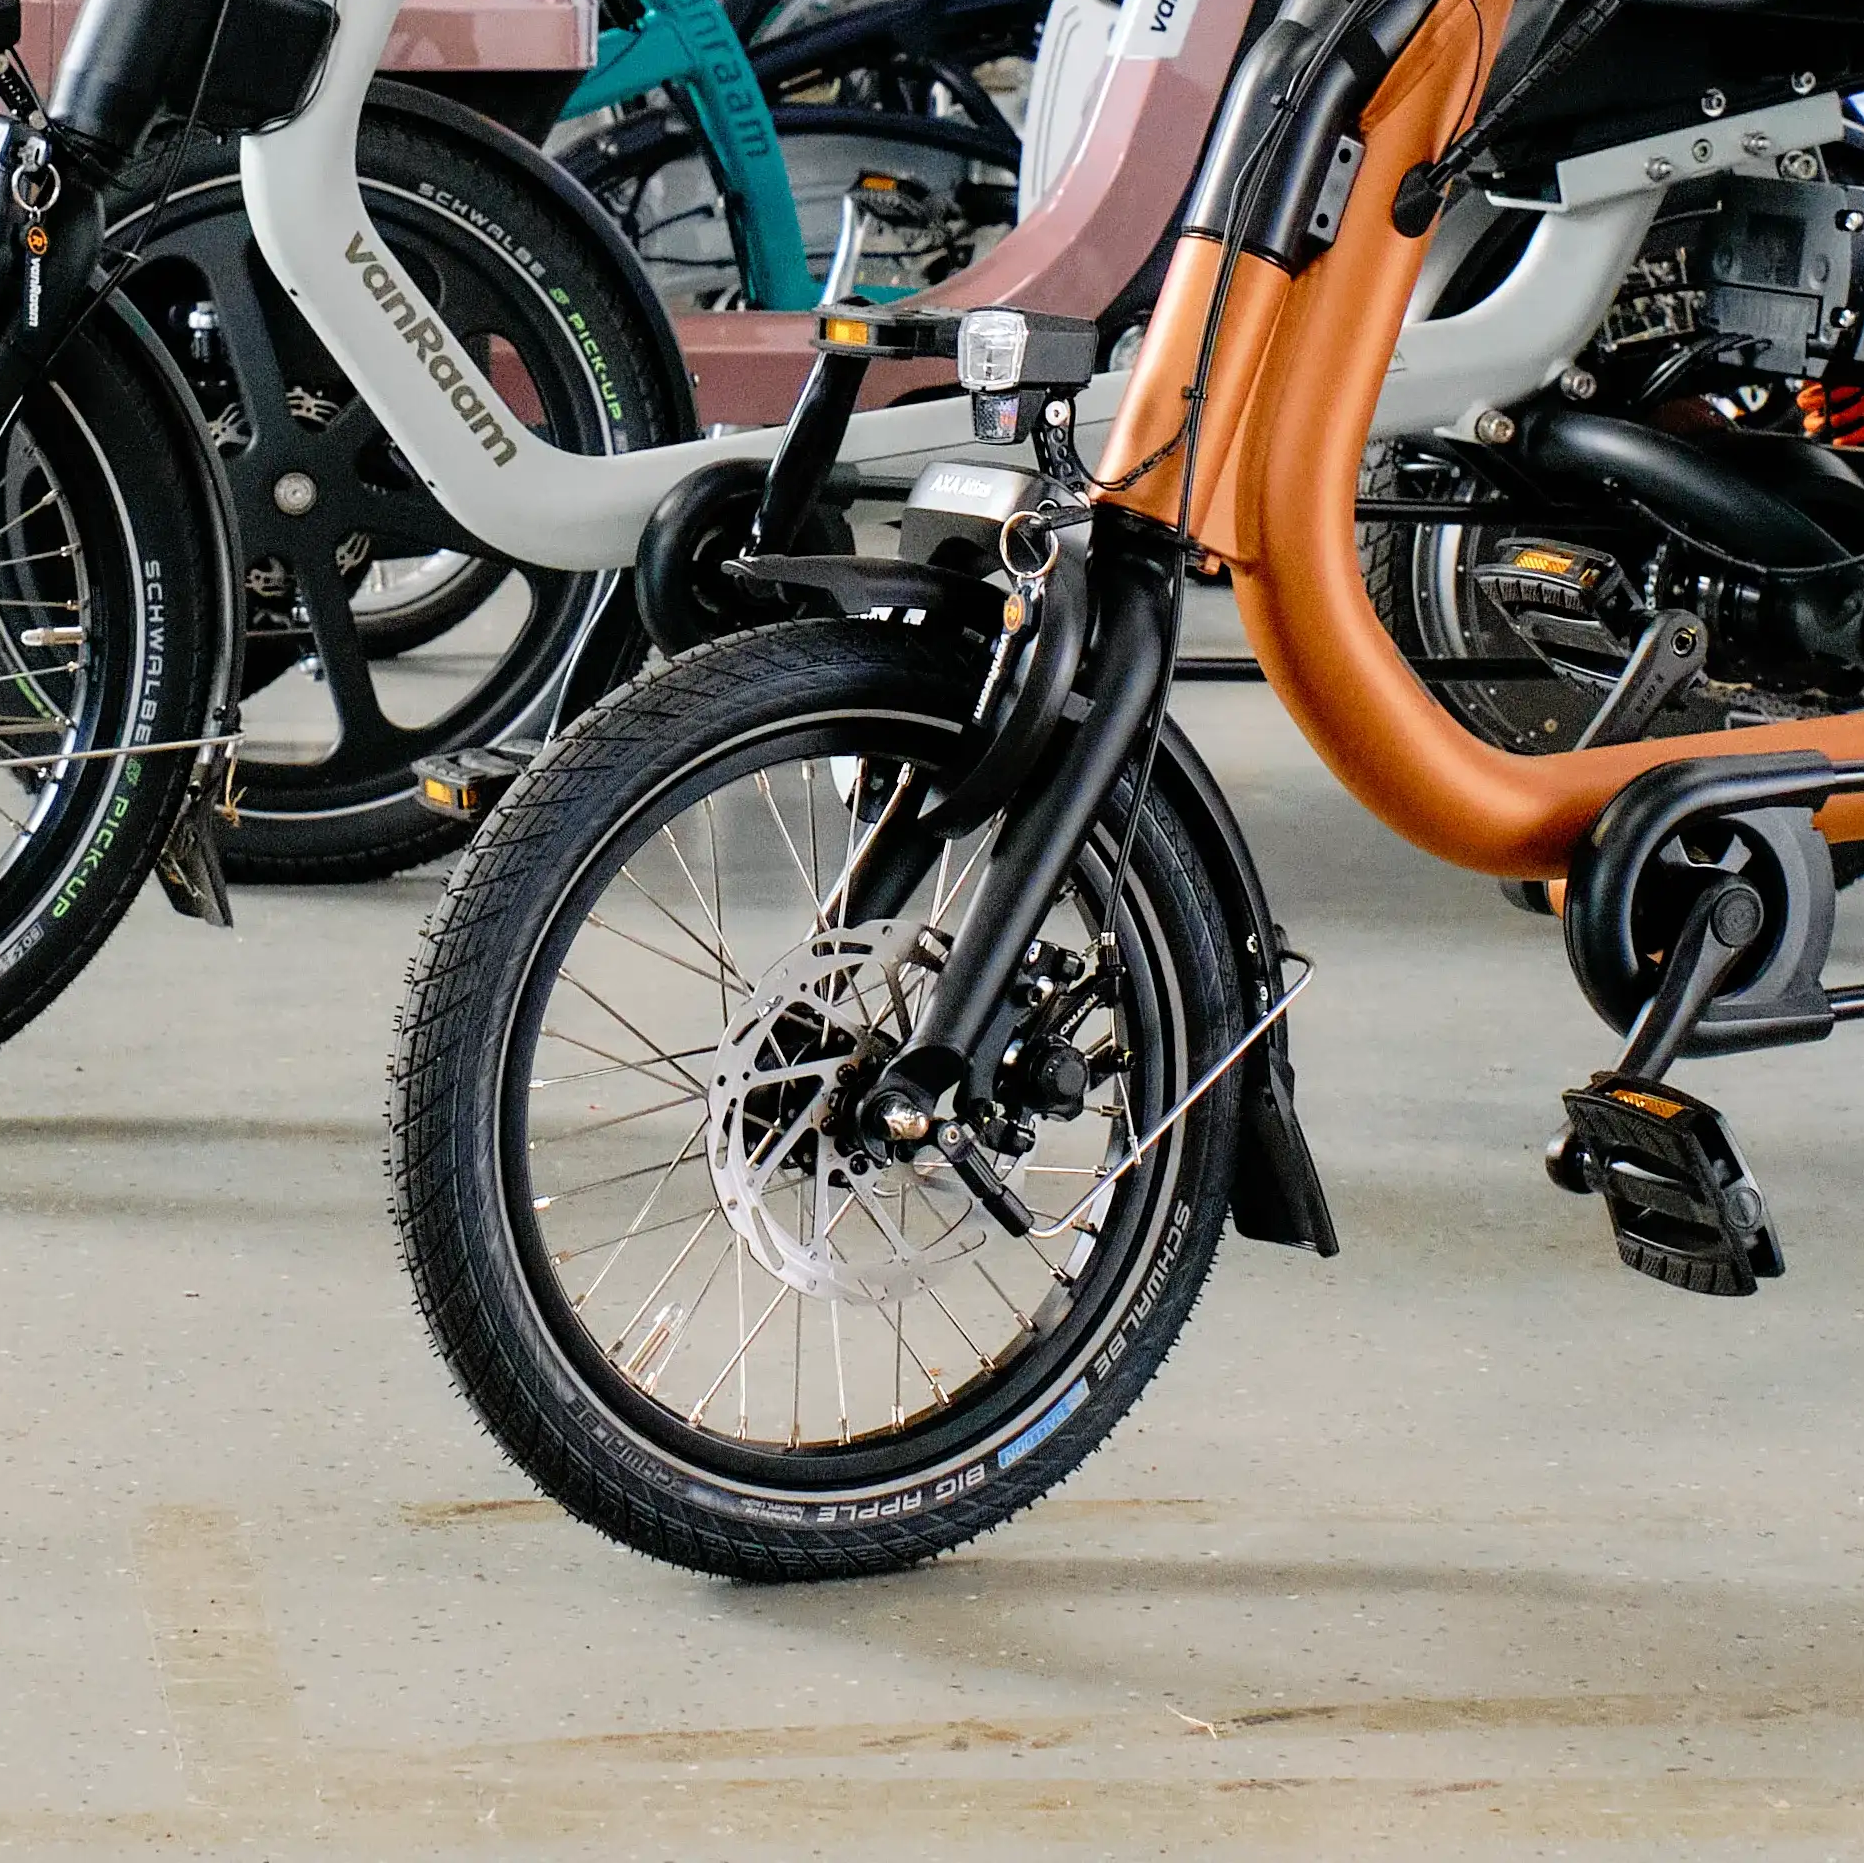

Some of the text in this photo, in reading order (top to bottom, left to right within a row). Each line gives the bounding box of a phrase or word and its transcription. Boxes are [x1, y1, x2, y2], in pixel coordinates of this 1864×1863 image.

[343, 230, 519, 469] vanRaam
[415, 181, 623, 422] SCHWALBE PICK-UP
[929, 473, 962, 495] AXA
[133, 558, 167, 746] SCHWALBE
[51, 793, 132, 920] PICK-UP
[1093, 1198, 1194, 1382] SCHWALBE
[816, 1490, 924, 1525] APPLE
[935, 1461, 987, 1504] BIG
